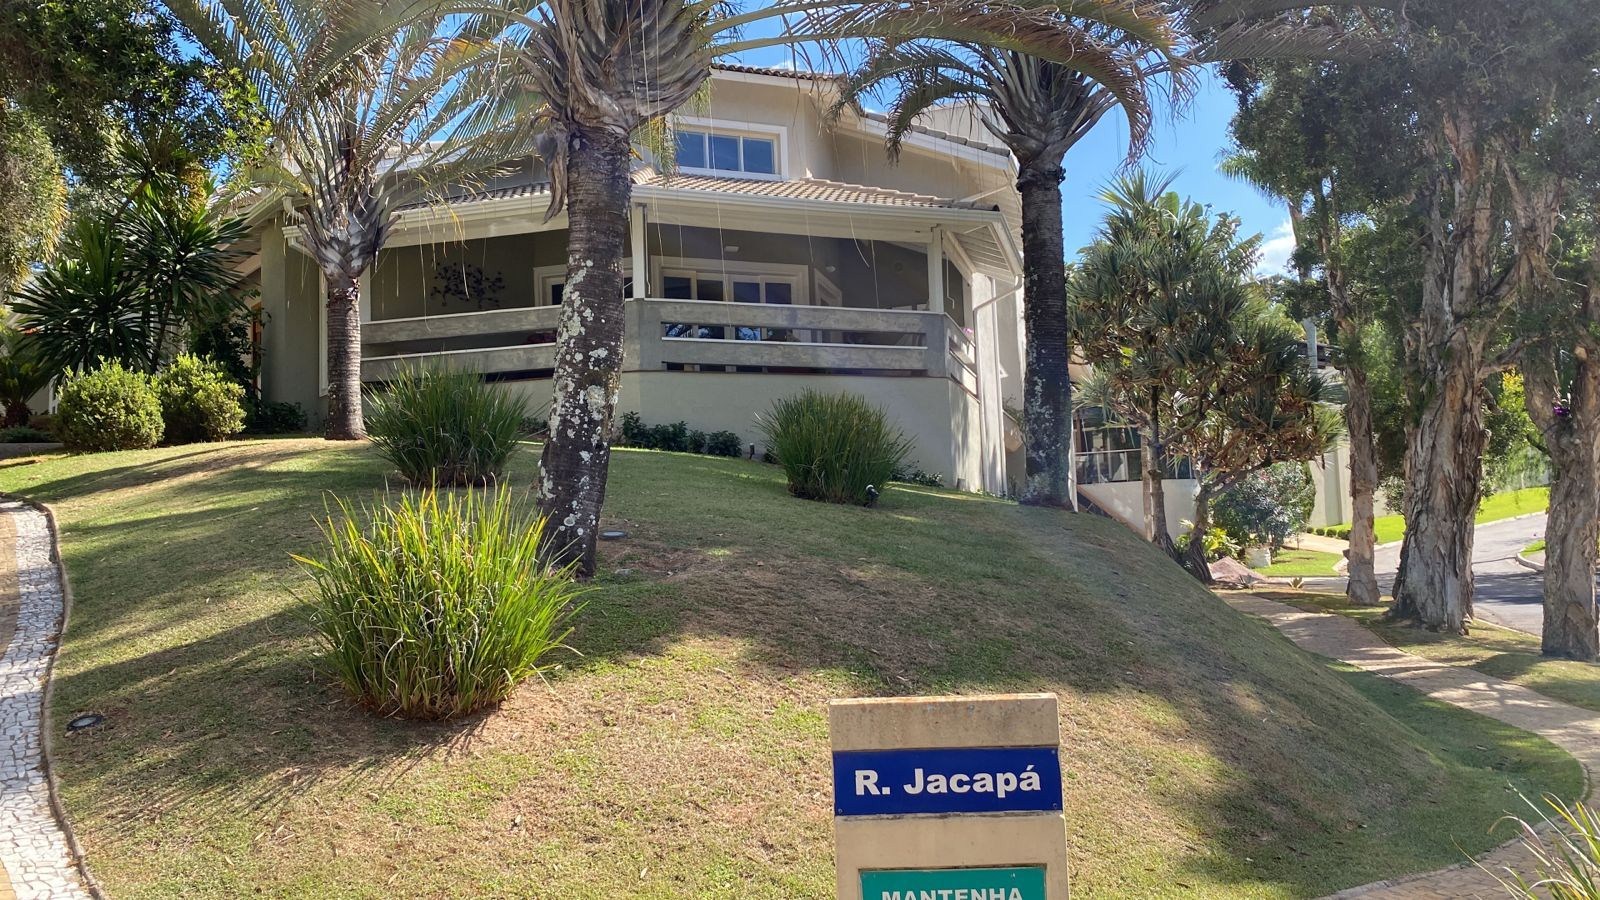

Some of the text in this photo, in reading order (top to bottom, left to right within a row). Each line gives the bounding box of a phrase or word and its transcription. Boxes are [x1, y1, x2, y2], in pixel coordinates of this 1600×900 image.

[854, 764, 1041, 798] R. Jacapá
[881, 887, 1023, 900] MANTENHA
